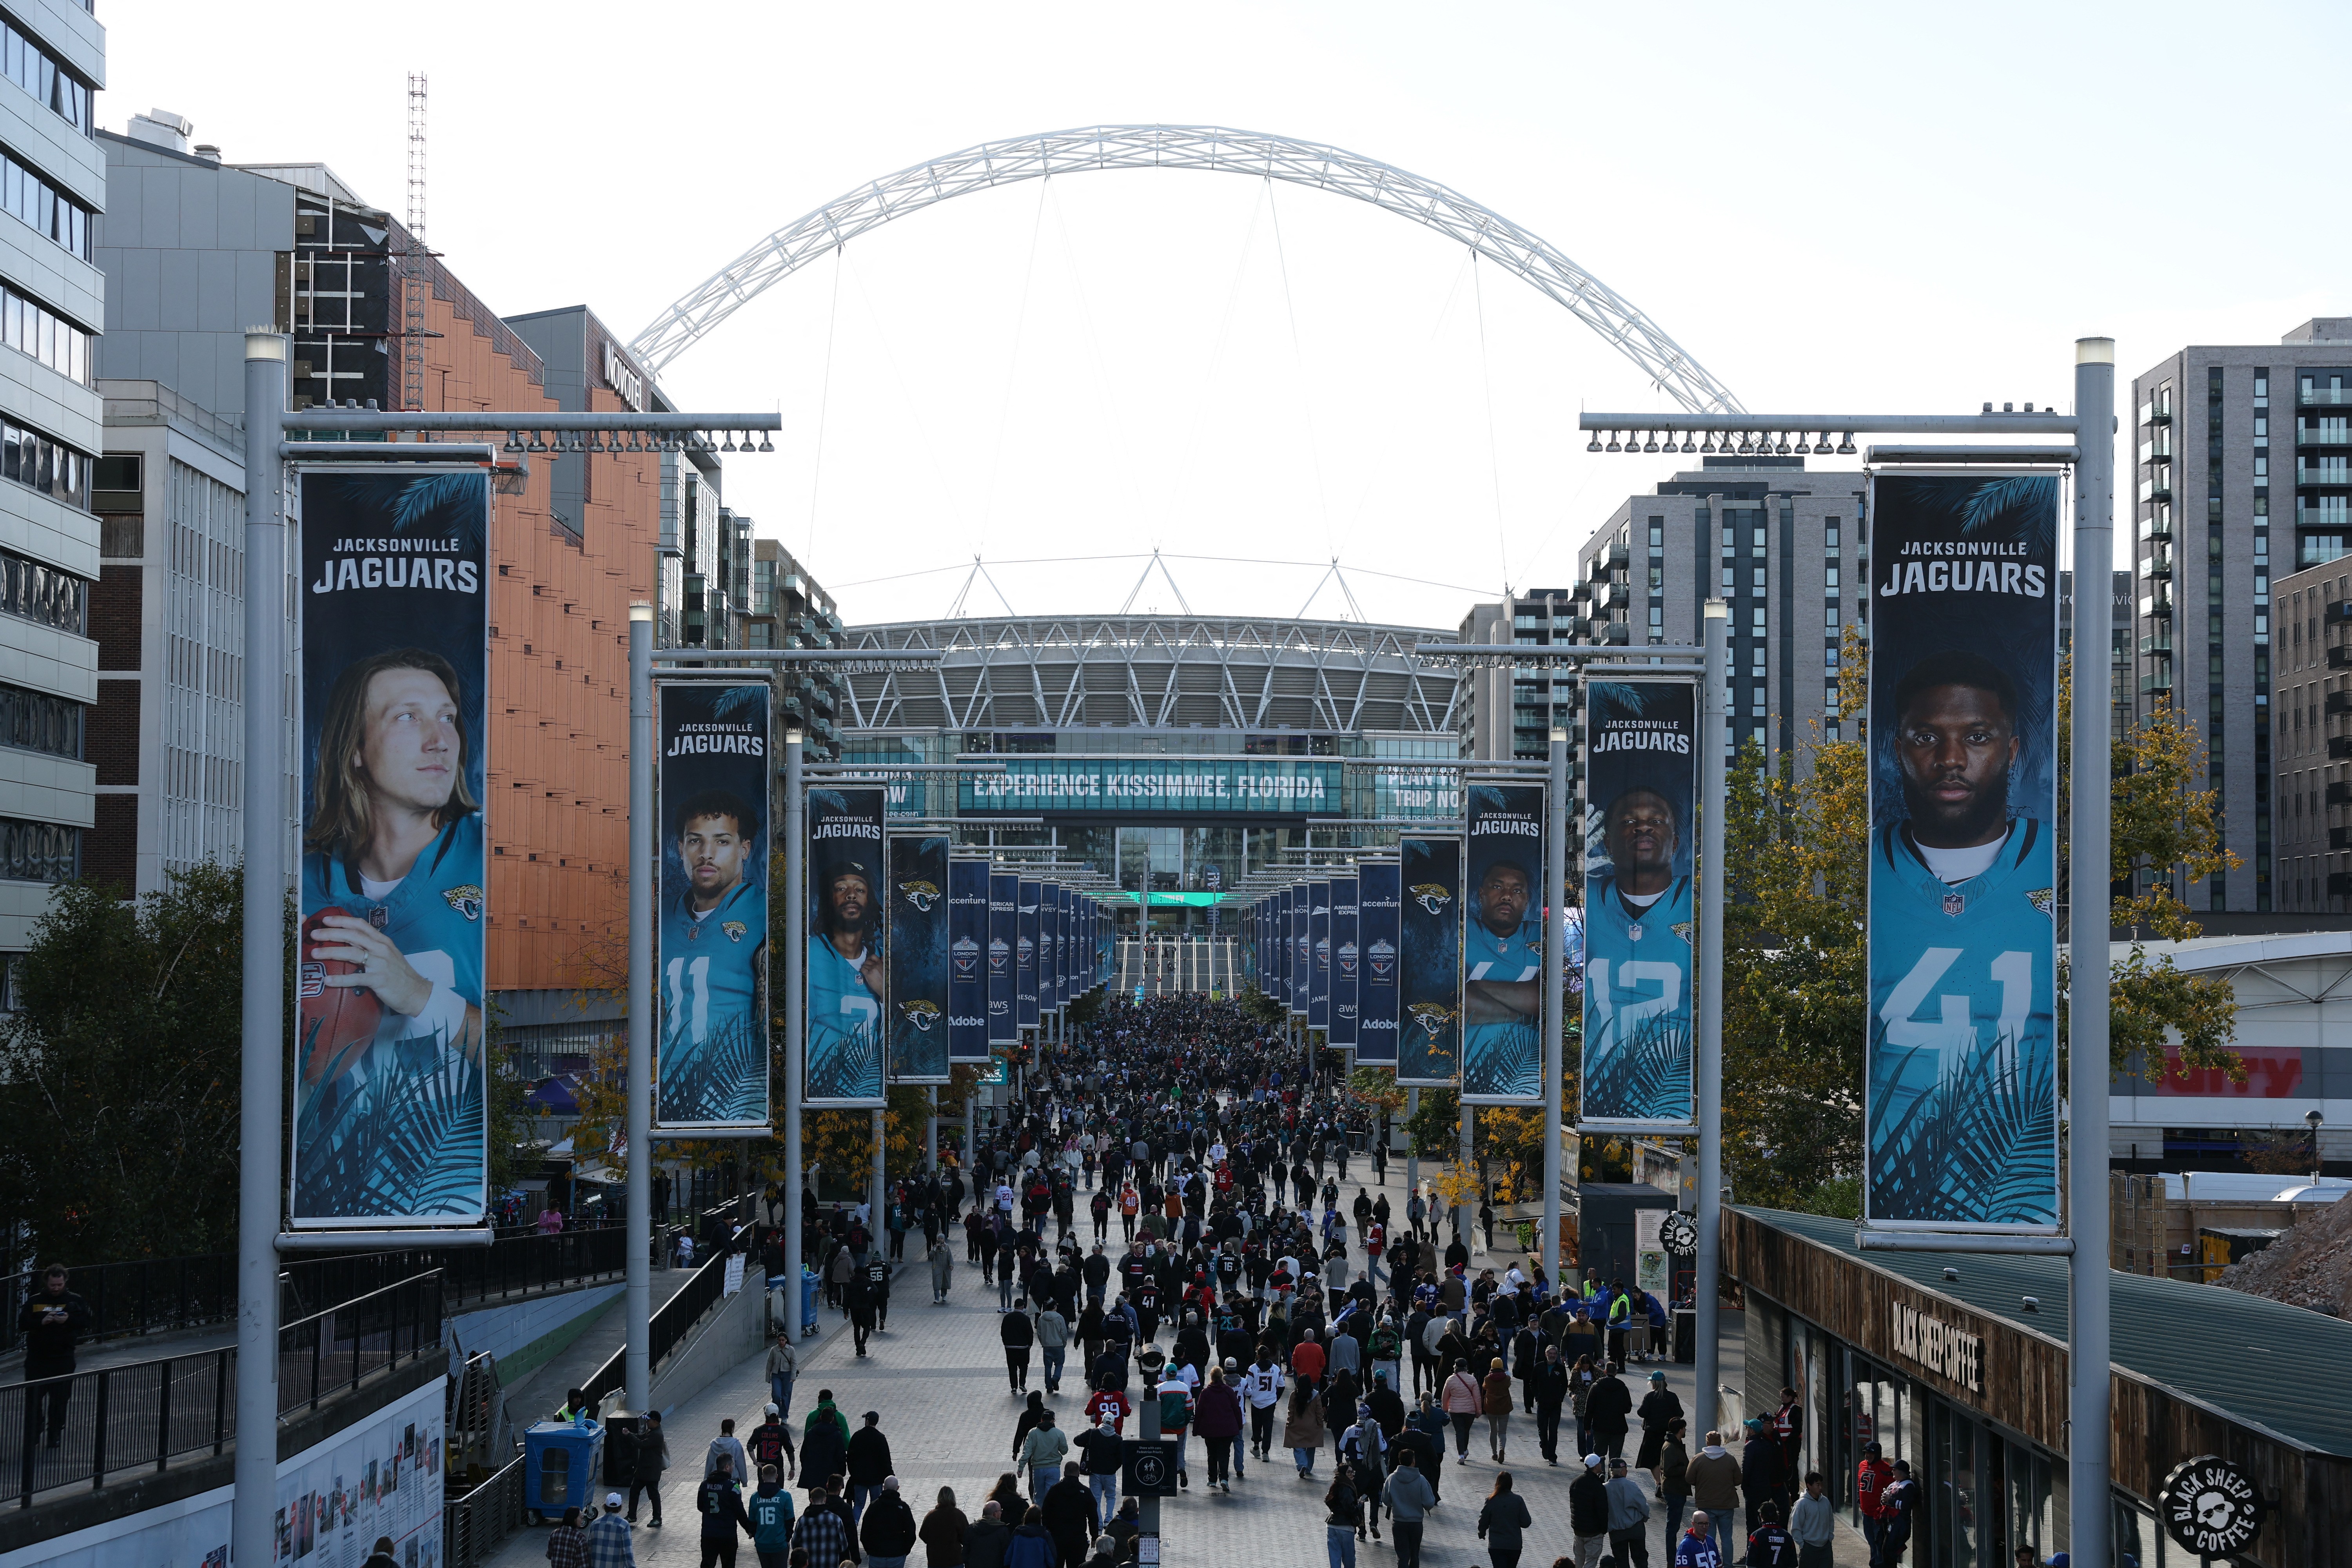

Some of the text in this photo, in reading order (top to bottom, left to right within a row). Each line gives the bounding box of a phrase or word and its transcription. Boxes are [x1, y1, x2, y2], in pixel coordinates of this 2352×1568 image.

[605, 341, 644, 412] NOVOTEL
[333, 539, 459, 552] JACKSONVILLE
[1901, 542, 2027, 555] JACKSONVILLE
[313, 558, 477, 593] JAGUARS
[1880, 561, 2045, 598] JAGUARS
[2112, 593, 2131, 605] ivi
[1606, 720, 1678, 729] JACKSONVILLE
[668, 735, 763, 757] JAGUARS
[1593, 731, 1689, 754] JAGUARS
[1437, 766, 1459, 786] YO
[975, 775, 1325, 799] EXPERIENCE KISSIMMEE, FLORIDA
[1394, 790, 1459, 808] TRIP NO
[813, 824, 880, 840] JAGUARS
[1471, 821, 1539, 837] JAGUARS
[1151, 895, 1185, 904] WEMBLEY
[1946, 903, 1960, 912] NFL
[667, 956, 710, 1044] 11
[1588, 958, 1682, 1058] 12
[949, 1016, 984, 1026] Adobe
[1362, 1019, 1399, 1029] Adobe
[1880, 947, 2032, 1094] 41
[1566, 1151, 1576, 1176] DOGS
[1125, 1196, 1136, 1207] 40
[1250, 1203, 1256, 1212] 7
[1256, 1220, 1263, 1229] 14
[1224, 1262, 1233, 1271] 16
[1142, 1296, 1154, 1308] 41
[1425, 1294, 1435, 1303] 17
[1893, 1301, 1978, 1392] BLACK SHEEP COFFEE
[1259, 1376, 1273, 1391] 51
[1099, 1402, 1120, 1418] 99
[761, 1440, 780, 1460] 12
[1860, 1472, 1876, 1493] 51
[708, 1492, 720, 1514] 3
[2173, 1468, 2252, 1521] BLACK SHEEP
[759, 1506, 775, 1525] 16
[2197, 1516, 2255, 1552] COFFEE
[1771, 1545, 1781, 1565] 7
